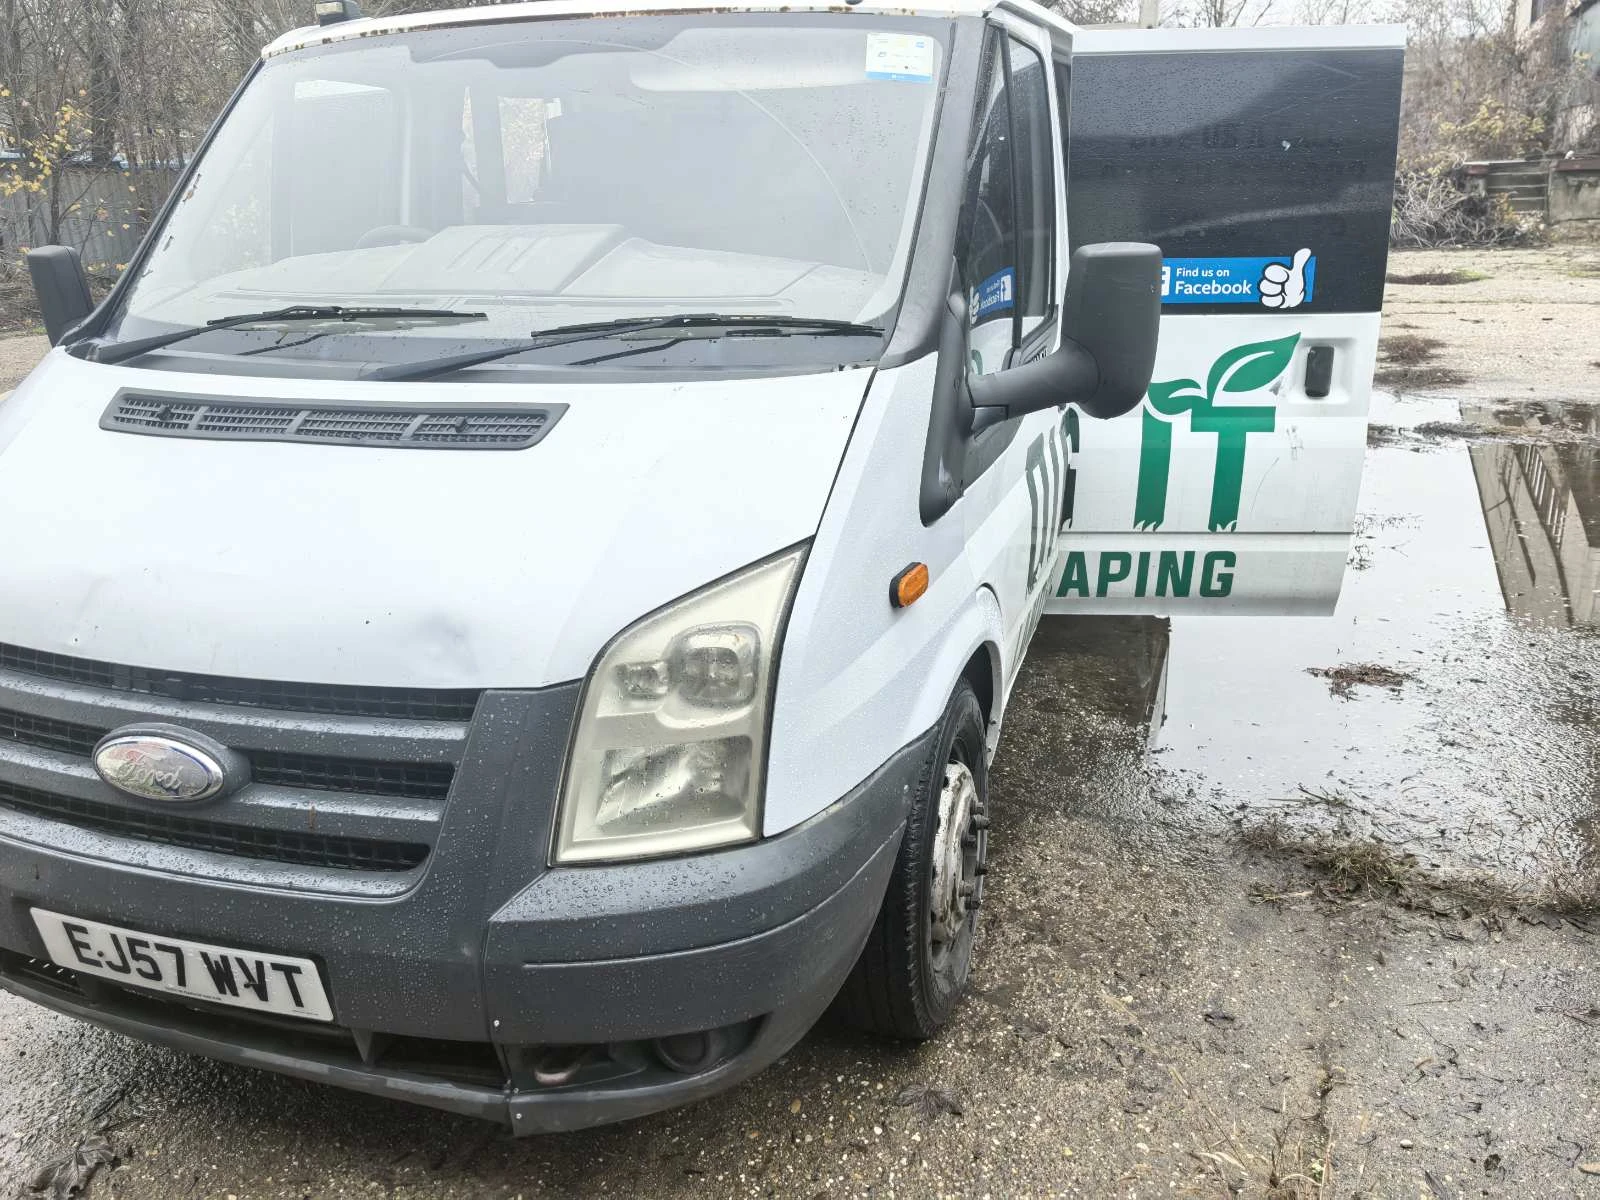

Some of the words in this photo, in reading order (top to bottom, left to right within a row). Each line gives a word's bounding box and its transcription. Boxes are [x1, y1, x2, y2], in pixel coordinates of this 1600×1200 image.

[1175, 280, 1252, 295] Facebook
[1176, 267, 1199, 277] Find
[1201, 269, 1214, 277] us
[1216, 269, 1230, 277] on
[1056, 551, 1237, 598] APING
[63, 922, 188, 987] EJ57
[199, 951, 304, 1008] WVT
